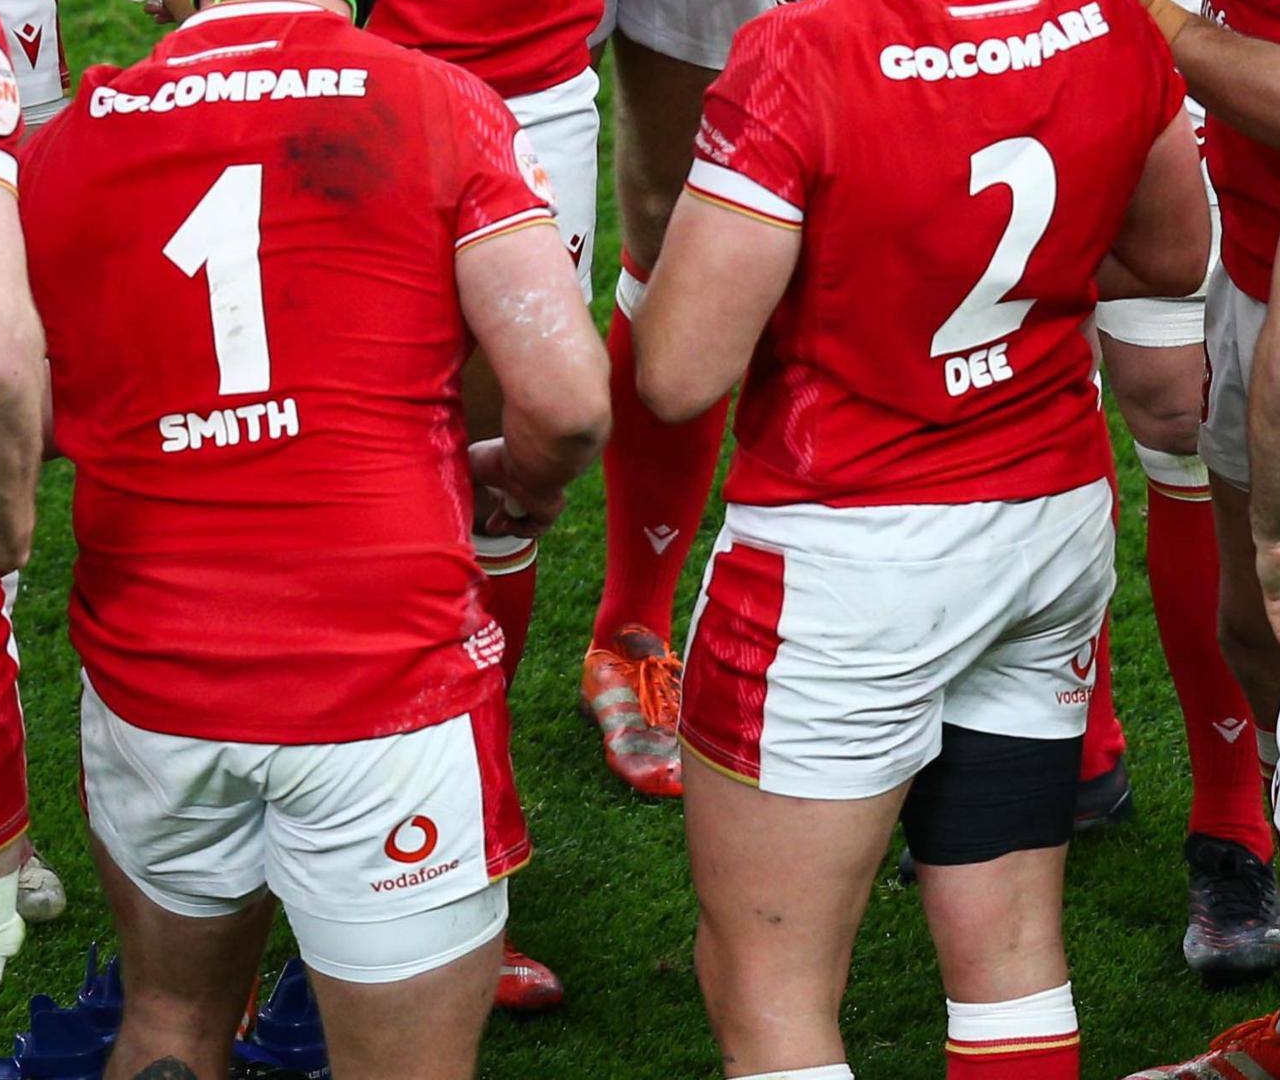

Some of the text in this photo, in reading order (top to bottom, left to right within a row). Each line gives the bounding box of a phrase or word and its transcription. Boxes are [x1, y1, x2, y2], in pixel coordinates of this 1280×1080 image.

[89, 68, 368, 118] GO.COMPARE
[930, 136, 1058, 357] 2
[162, 164, 270, 395] 1
[944, 342, 1014, 397] DEE
[159, 398, 299, 452] SMITH
[370, 859, 460, 892] vodafone
